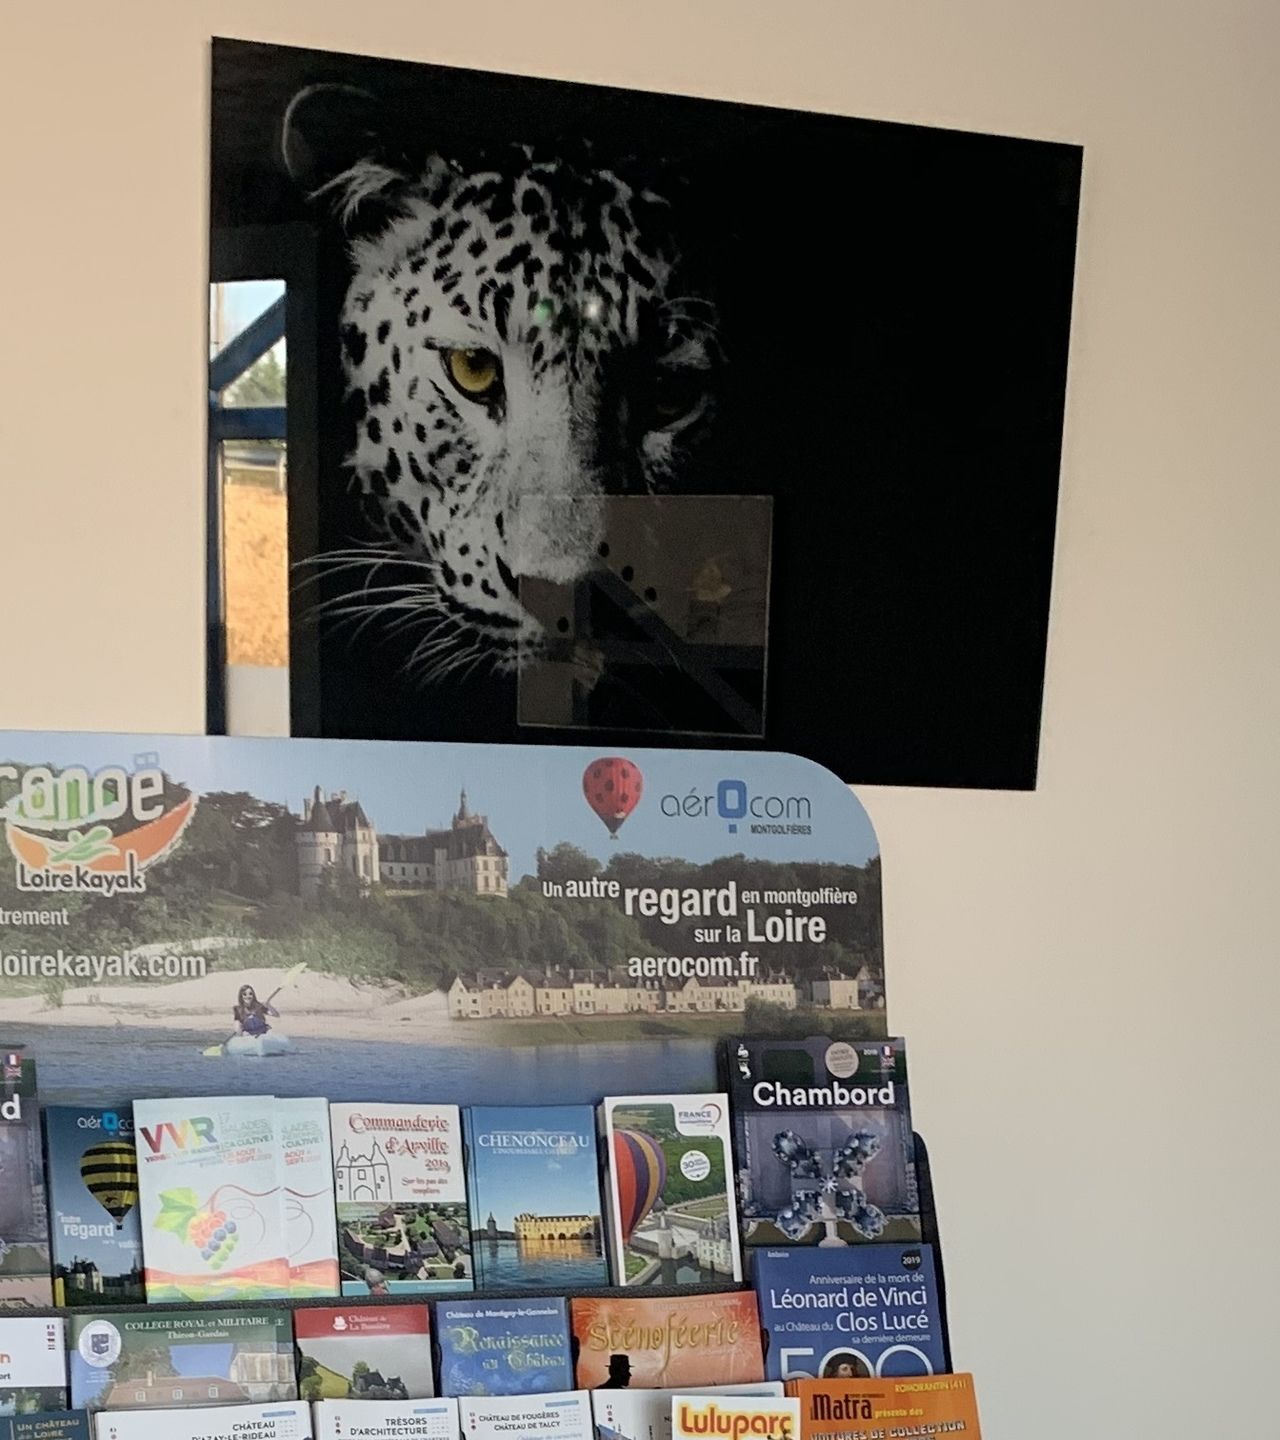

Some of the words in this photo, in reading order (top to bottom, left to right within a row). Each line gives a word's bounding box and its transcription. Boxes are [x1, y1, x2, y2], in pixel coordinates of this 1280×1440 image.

[19, 854, 145, 893] LoireKayak
[543, 882, 562, 897] Un
[566, 878, 619, 898] autre
[625, 882, 736, 923] regard
[742, 891, 760, 904] en
[764, 887, 857, 907] montgolfière
[695, 927, 720, 943] sur
[725, 926, 741, 942] la
[747, 910, 826, 943] Loire
[628, 952, 758, 977] aerocom.fr
[753, 1081, 895, 1106] Chambord
[679, 1110, 711, 1118] FRANCE
[479, 1134, 590, 1147] CHENONCEAU
[64, 1221, 114, 1240] regard
[903, 1256, 920, 1265] 2019
[809, 1274, 863, 1286] Anniversaire
[889, 1274, 910, 1284] mort
[912, 1272, 924, 1282] de
[771, 1289, 850, 1309] Léonard
[853, 1290, 876, 1307] de
[882, 1286, 927, 1306] Vinci
[173, 1319, 207, 1329] ROYAL
[217, 1317, 268, 1328] MILITAIRE
[837, 1312, 878, 1331] Clos
[883, 1309, 929, 1329] Lucé
[812, 1394, 872, 1420] Matra
[385, 1416, 427, 1426] TRÉSORS
[479, 1412, 509, 1422] CHÂTEAU
[521, 1410, 559, 1421] FOUGÈRES
[36, 1419, 79, 1430] CHÂTEAU
[233, 1419, 275, 1431] CHÂTEAU
[494, 1422, 525, 1431] CHÂTEAU
[538, 1421, 560, 1429] TALCY
[680, 1406, 791, 1440] Luluparc
[34, 1430, 63, 1438] LOIRE
[350, 1426, 428, 1436] D'ARCHITECTURE
